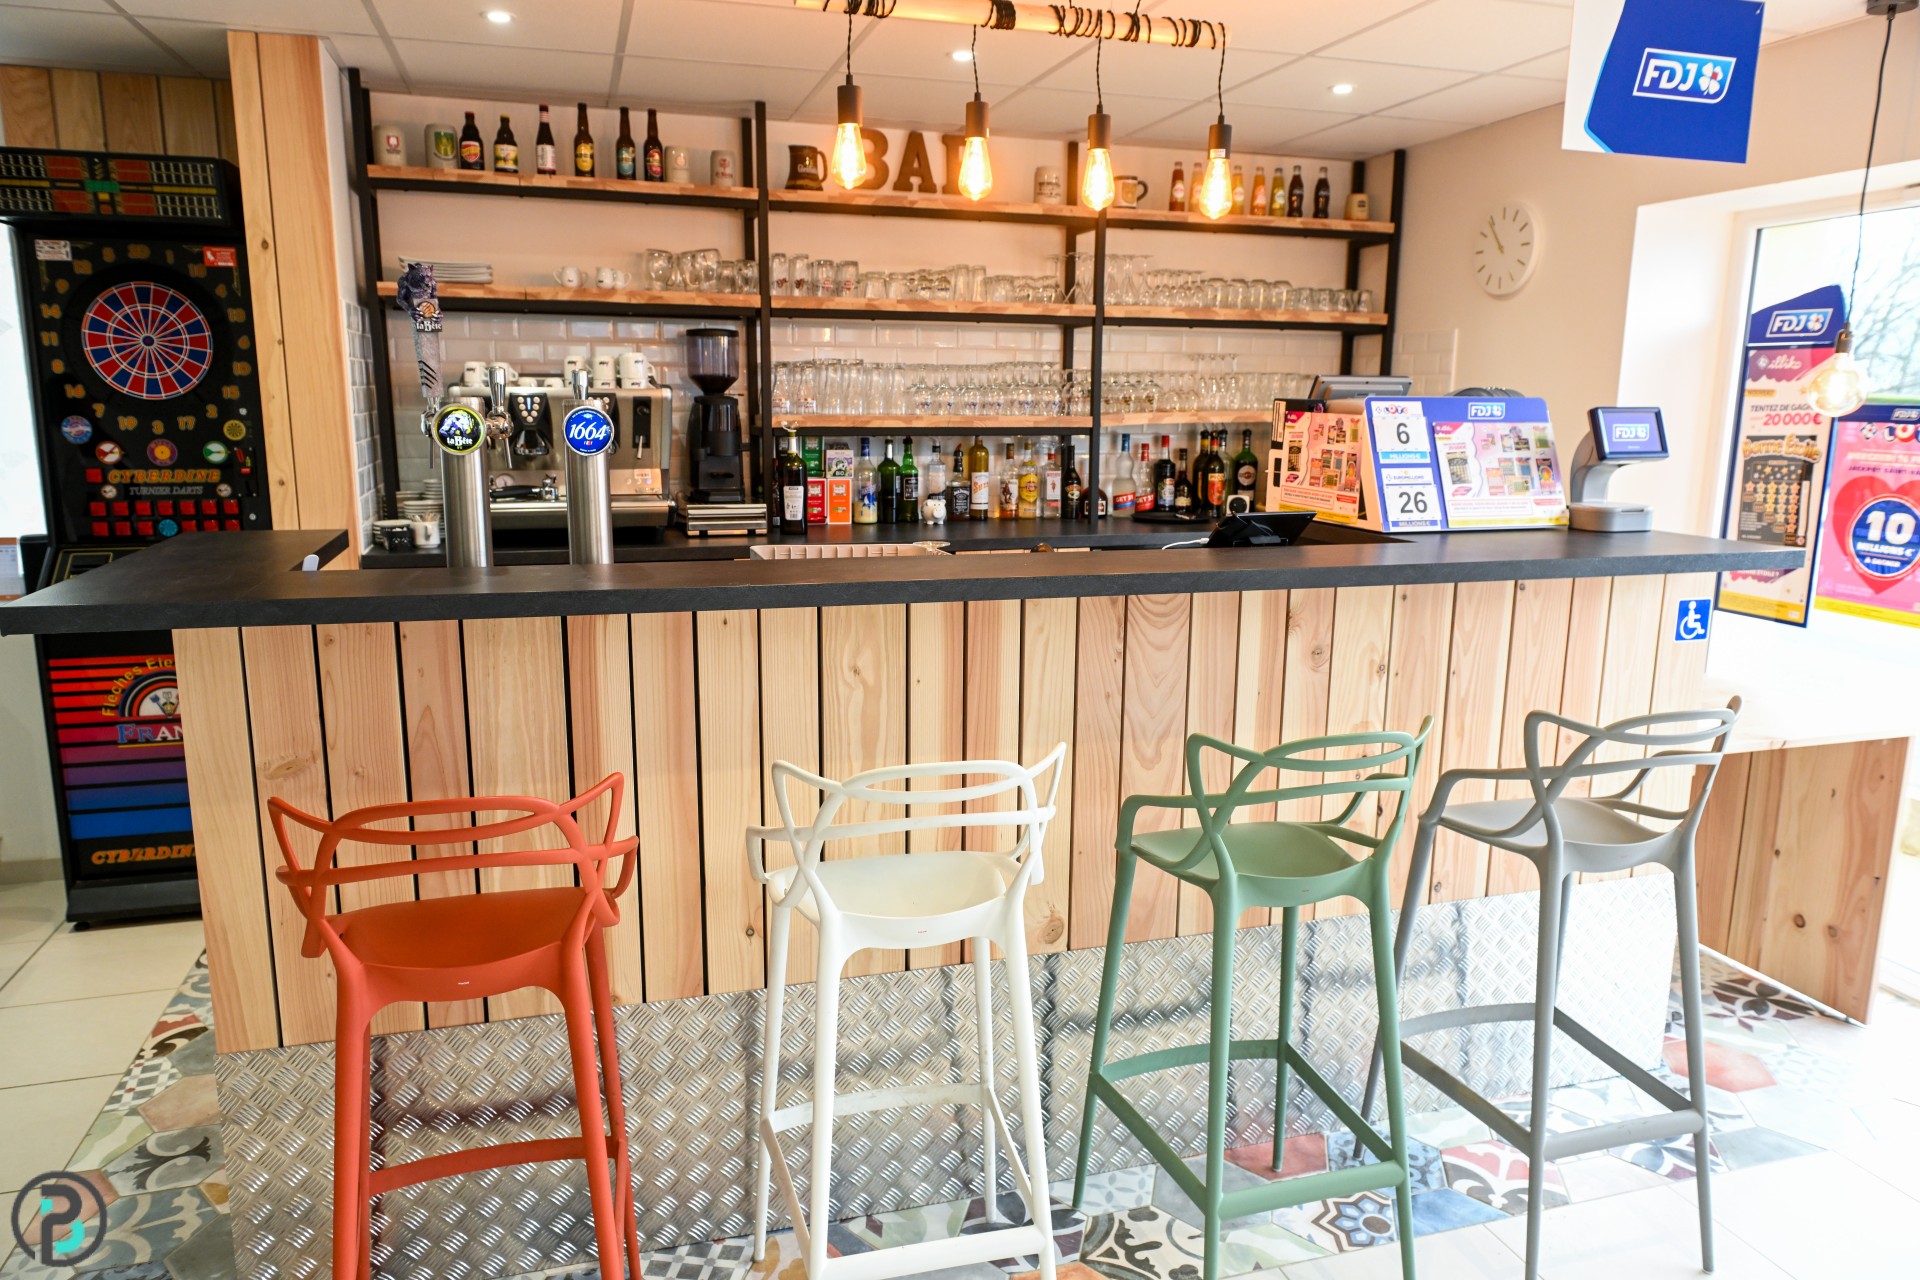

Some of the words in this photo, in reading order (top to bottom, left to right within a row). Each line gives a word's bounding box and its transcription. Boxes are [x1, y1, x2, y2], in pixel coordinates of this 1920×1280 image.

[1642, 58, 1699, 92] FDJ
[40, 303, 62, 319] 14
[1771, 314, 1808, 333] FDJ
[39, 330, 59, 347] 11
[92, 402, 105, 419] 7
[205, 403, 218, 419] 2
[1470, 405, 1492, 417] FDJ
[117, 415, 138, 431] 19
[151, 419, 164, 435] 3
[177, 415, 196, 431] 17
[569, 421, 607, 441] 1664
[1396, 422, 1410, 445] 6
[1615, 427, 1636, 439] FDJ
[107, 468, 221, 484] CYBERDINE
[129, 486, 171, 495] TURNIER
[172, 486, 204, 495] DARTS
[1399, 491, 1428, 513] 26
[1866, 510, 1917, 546] 10
[91, 845, 196, 865] CYBERDIN
